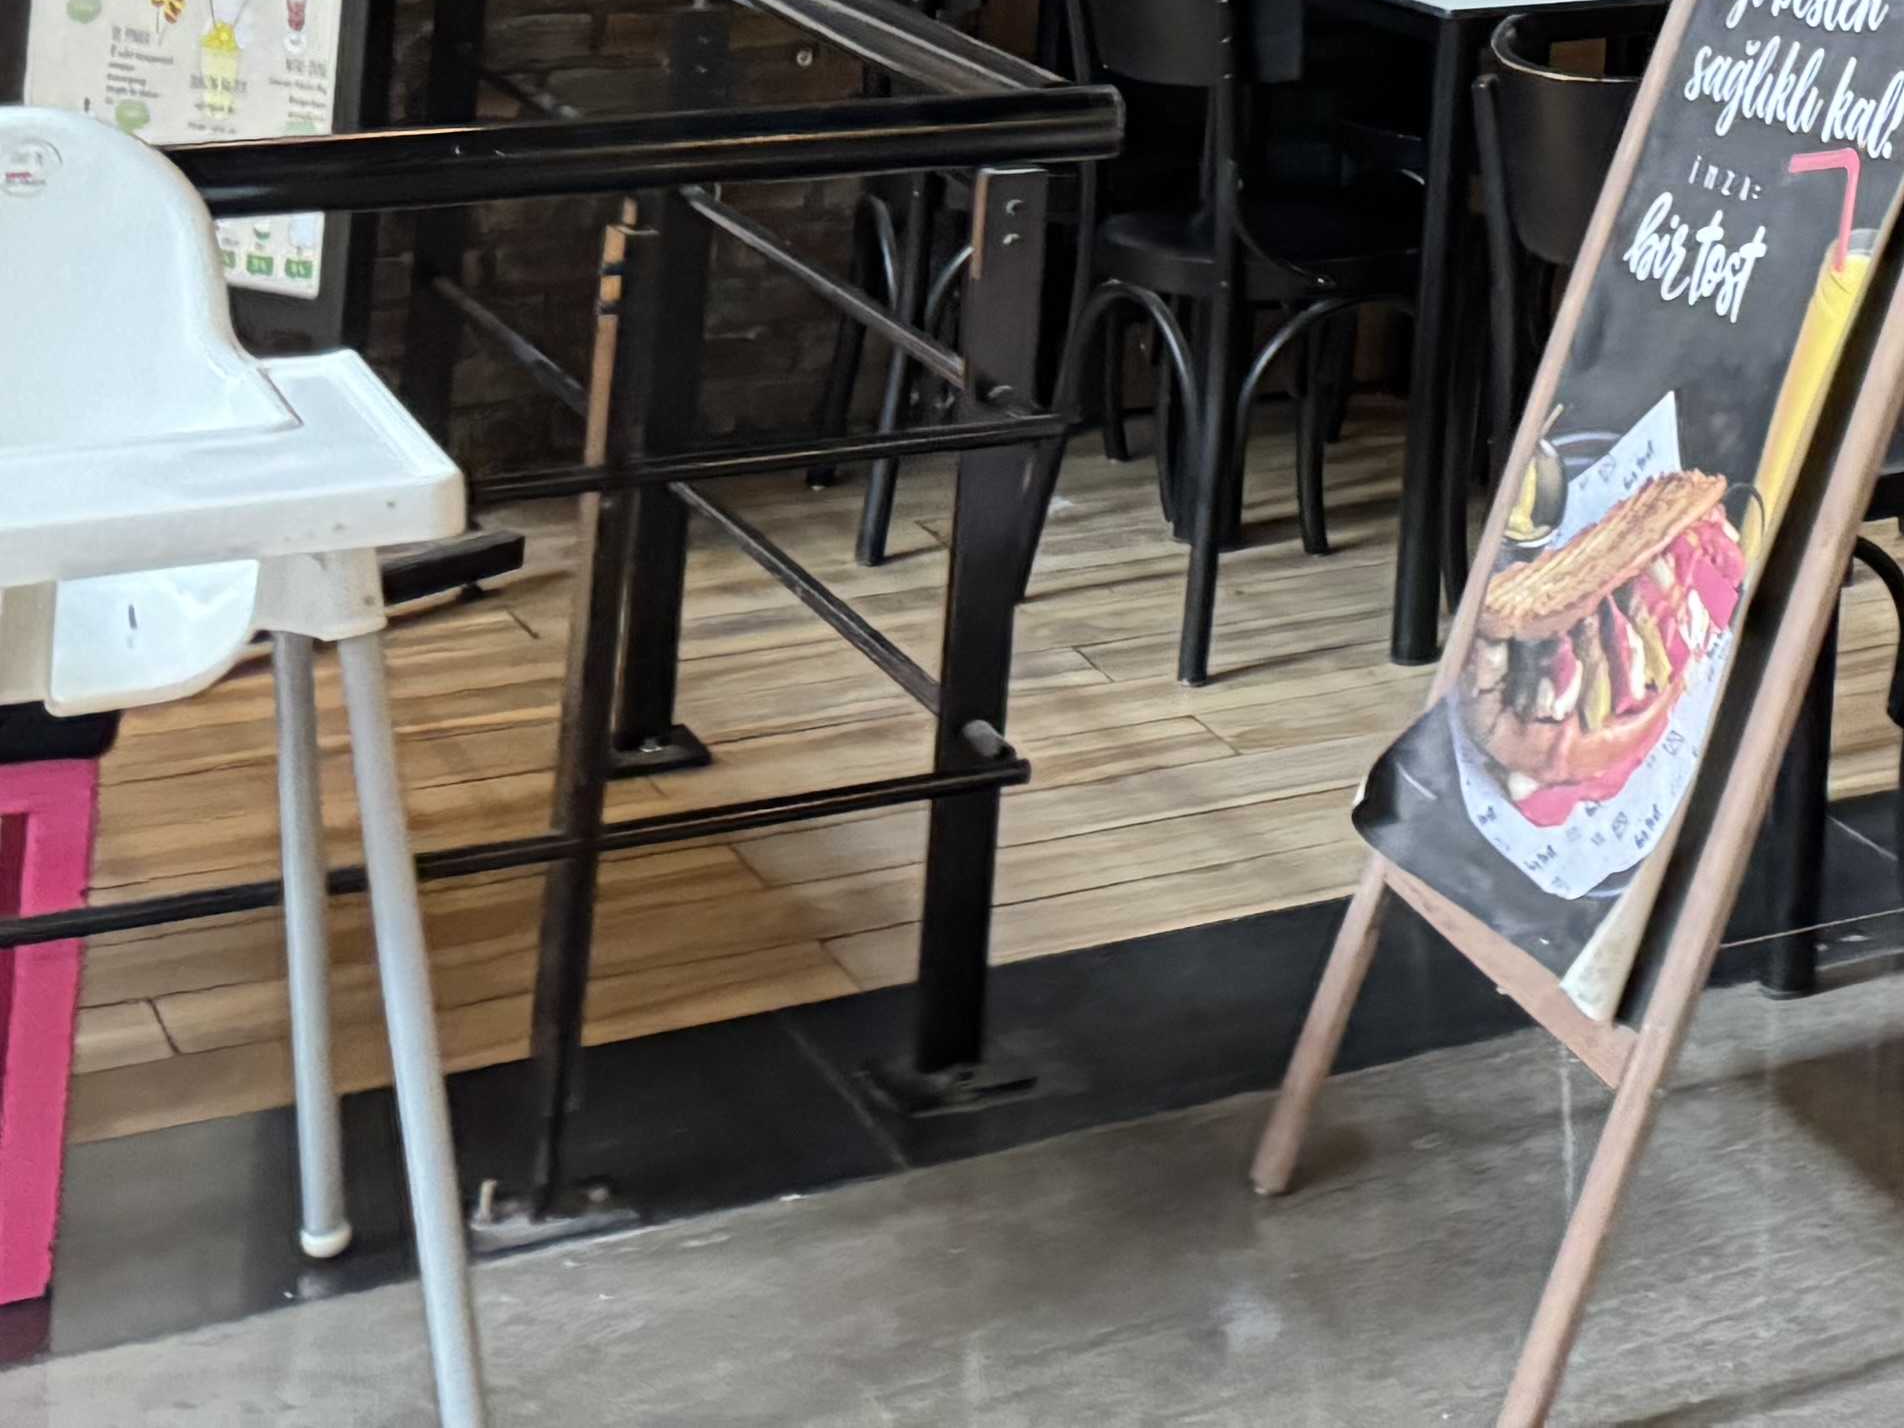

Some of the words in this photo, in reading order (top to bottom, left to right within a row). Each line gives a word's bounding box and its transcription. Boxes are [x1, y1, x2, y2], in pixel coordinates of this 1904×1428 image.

[1684, 35, 1825, 137] sağlıklı
[1622, 191, 1692, 301] bir
[1688, 209, 1768, 324] tost
